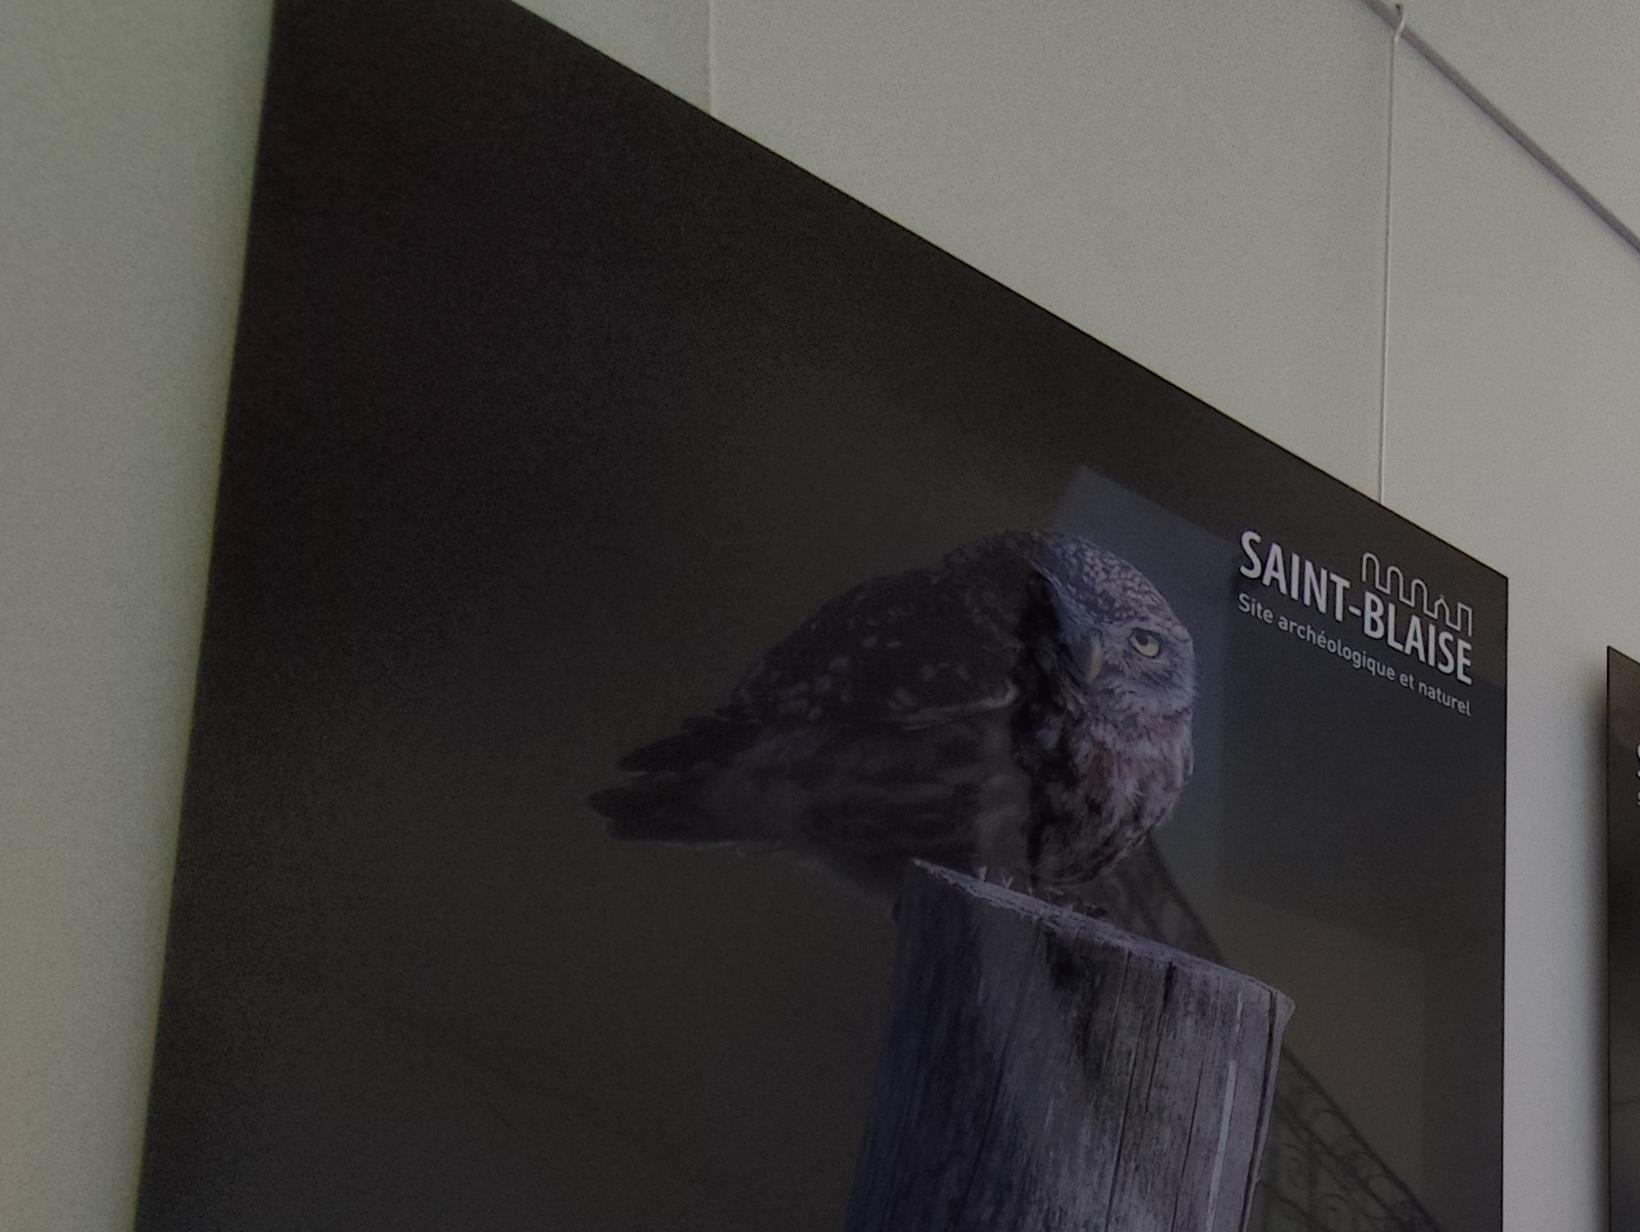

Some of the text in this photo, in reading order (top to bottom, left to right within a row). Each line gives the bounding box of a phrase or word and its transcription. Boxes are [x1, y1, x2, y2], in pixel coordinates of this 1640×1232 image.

[1238, 592, 1471, 716] Site archéologique et naturel
[1240, 530, 1472, 685] SAINT-BLAISE
